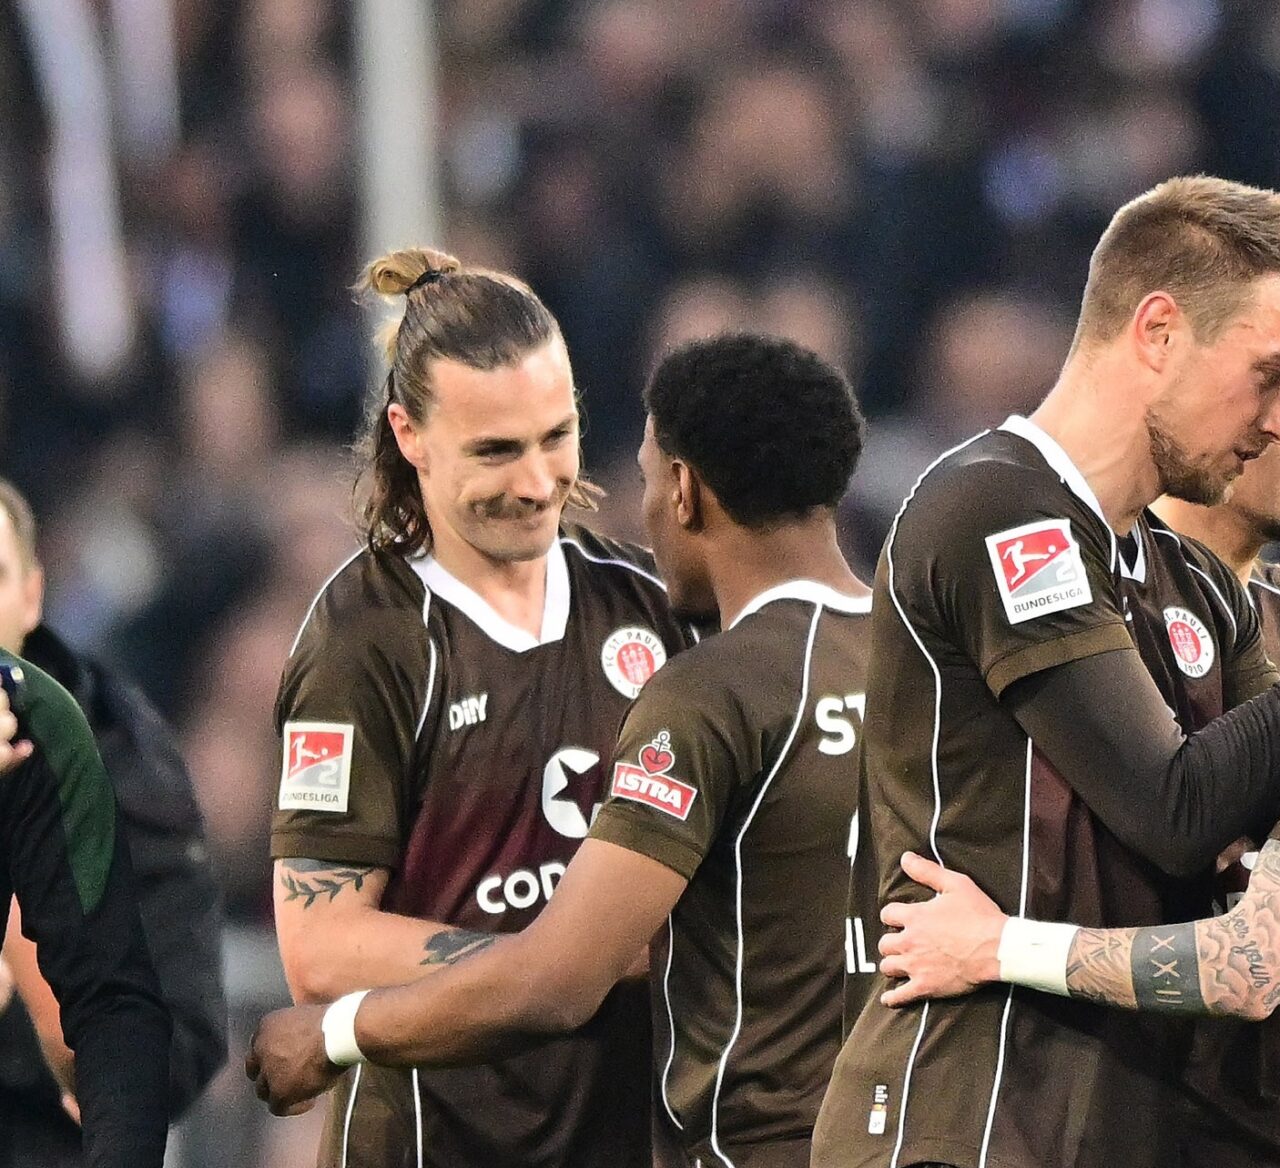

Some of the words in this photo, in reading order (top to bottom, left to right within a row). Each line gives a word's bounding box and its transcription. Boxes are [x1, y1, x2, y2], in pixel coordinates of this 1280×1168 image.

[1013, 587, 1084, 614] BUNDESLIGA
[626, 631, 662, 656] PAULI
[282, 792, 340, 803] NDESLIGA
